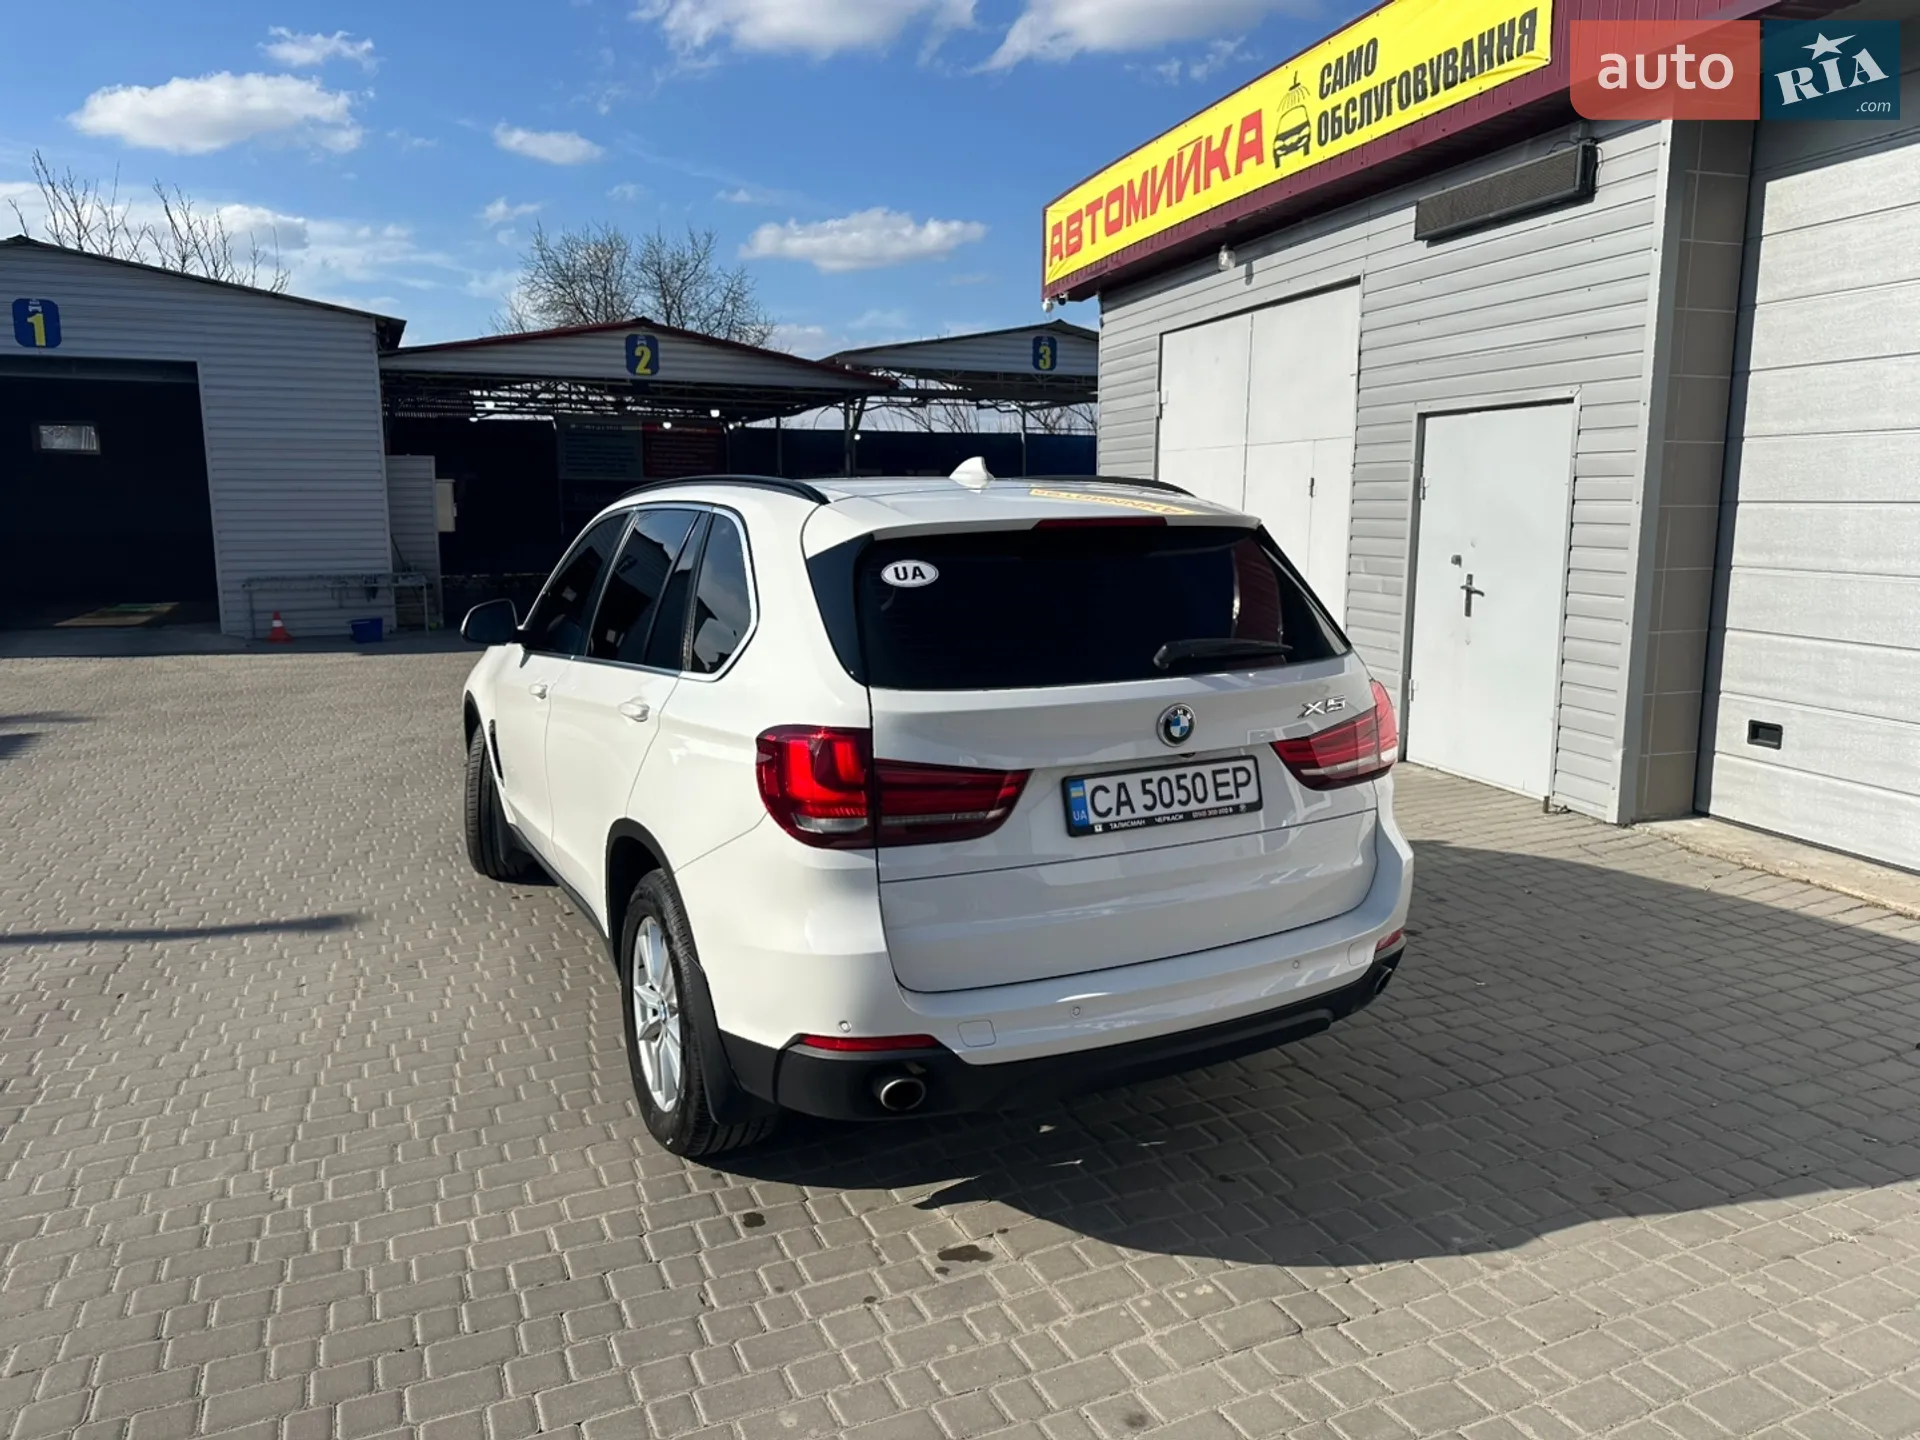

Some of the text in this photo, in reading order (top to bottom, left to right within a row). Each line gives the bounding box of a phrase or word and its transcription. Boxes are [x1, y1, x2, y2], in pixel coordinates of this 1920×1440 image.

[1317, 8, 1538, 148] ОБСЛУГОВУВАННЯ
[1319, 37, 1379, 101] САМО
[1048, 108, 1264, 267] АВТОМИЙКА
[27, 313, 46, 346] 1
[635, 346, 651, 374] 2
[1039, 346, 1051, 370] 3
[893, 566, 926, 581] UA
[1299, 695, 1346, 717] X5
[1141, 771, 1208, 811] 5050
[1073, 810, 1087, 821] UA
